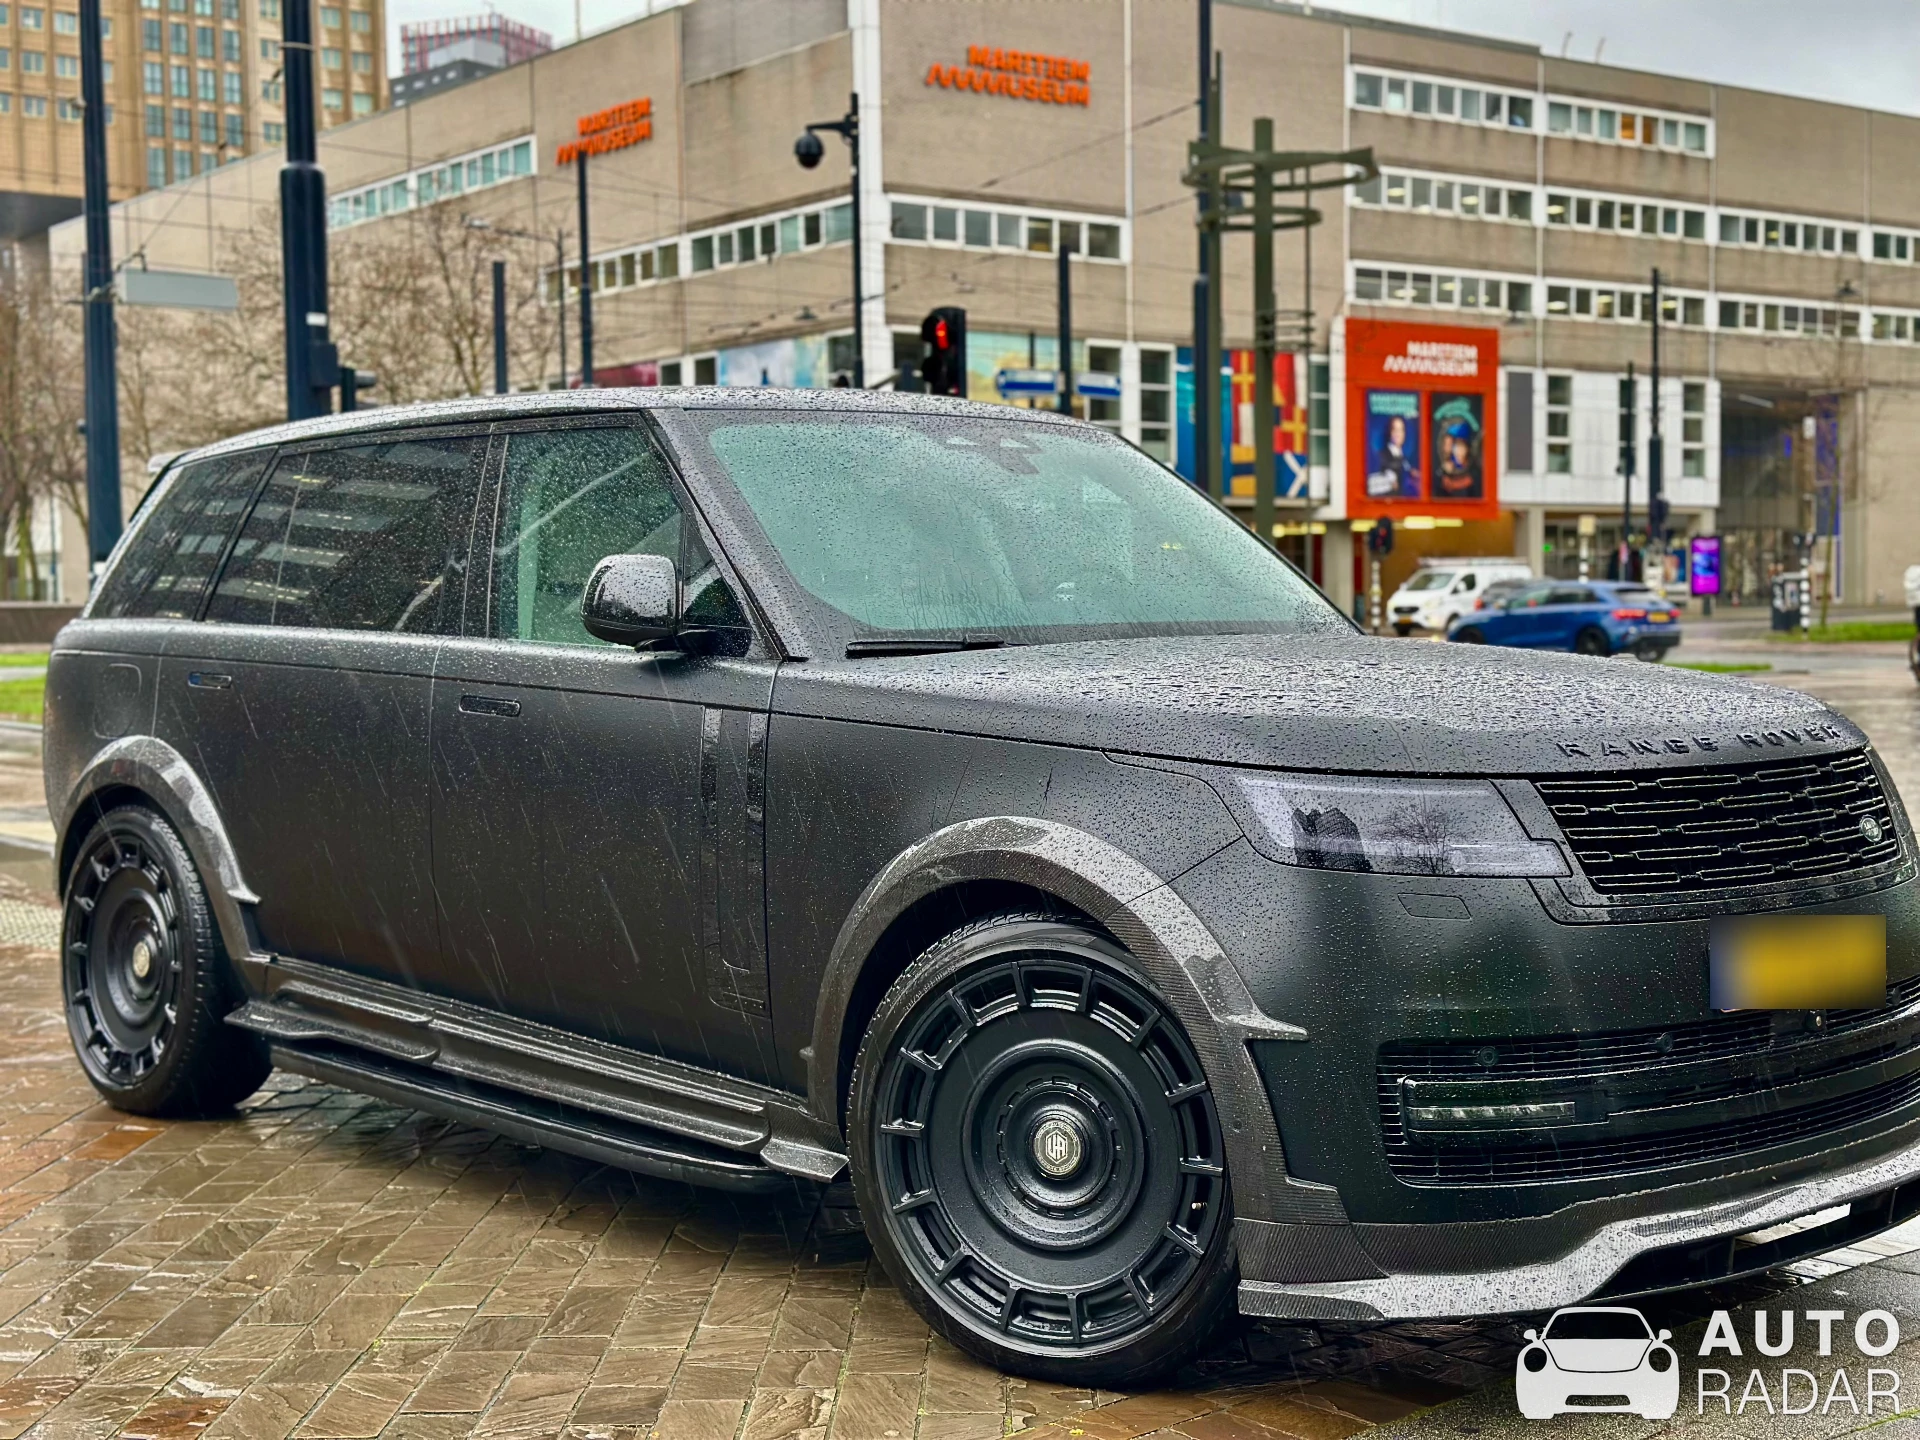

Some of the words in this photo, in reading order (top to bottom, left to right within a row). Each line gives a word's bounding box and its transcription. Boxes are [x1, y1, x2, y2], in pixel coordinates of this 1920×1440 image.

[968, 45, 1090, 82] MARITIEM
[1407, 341, 1478, 361] MARITIEM
[1555, 736, 1719, 758] RANGE
[1736, 724, 1842, 748] ROVER
